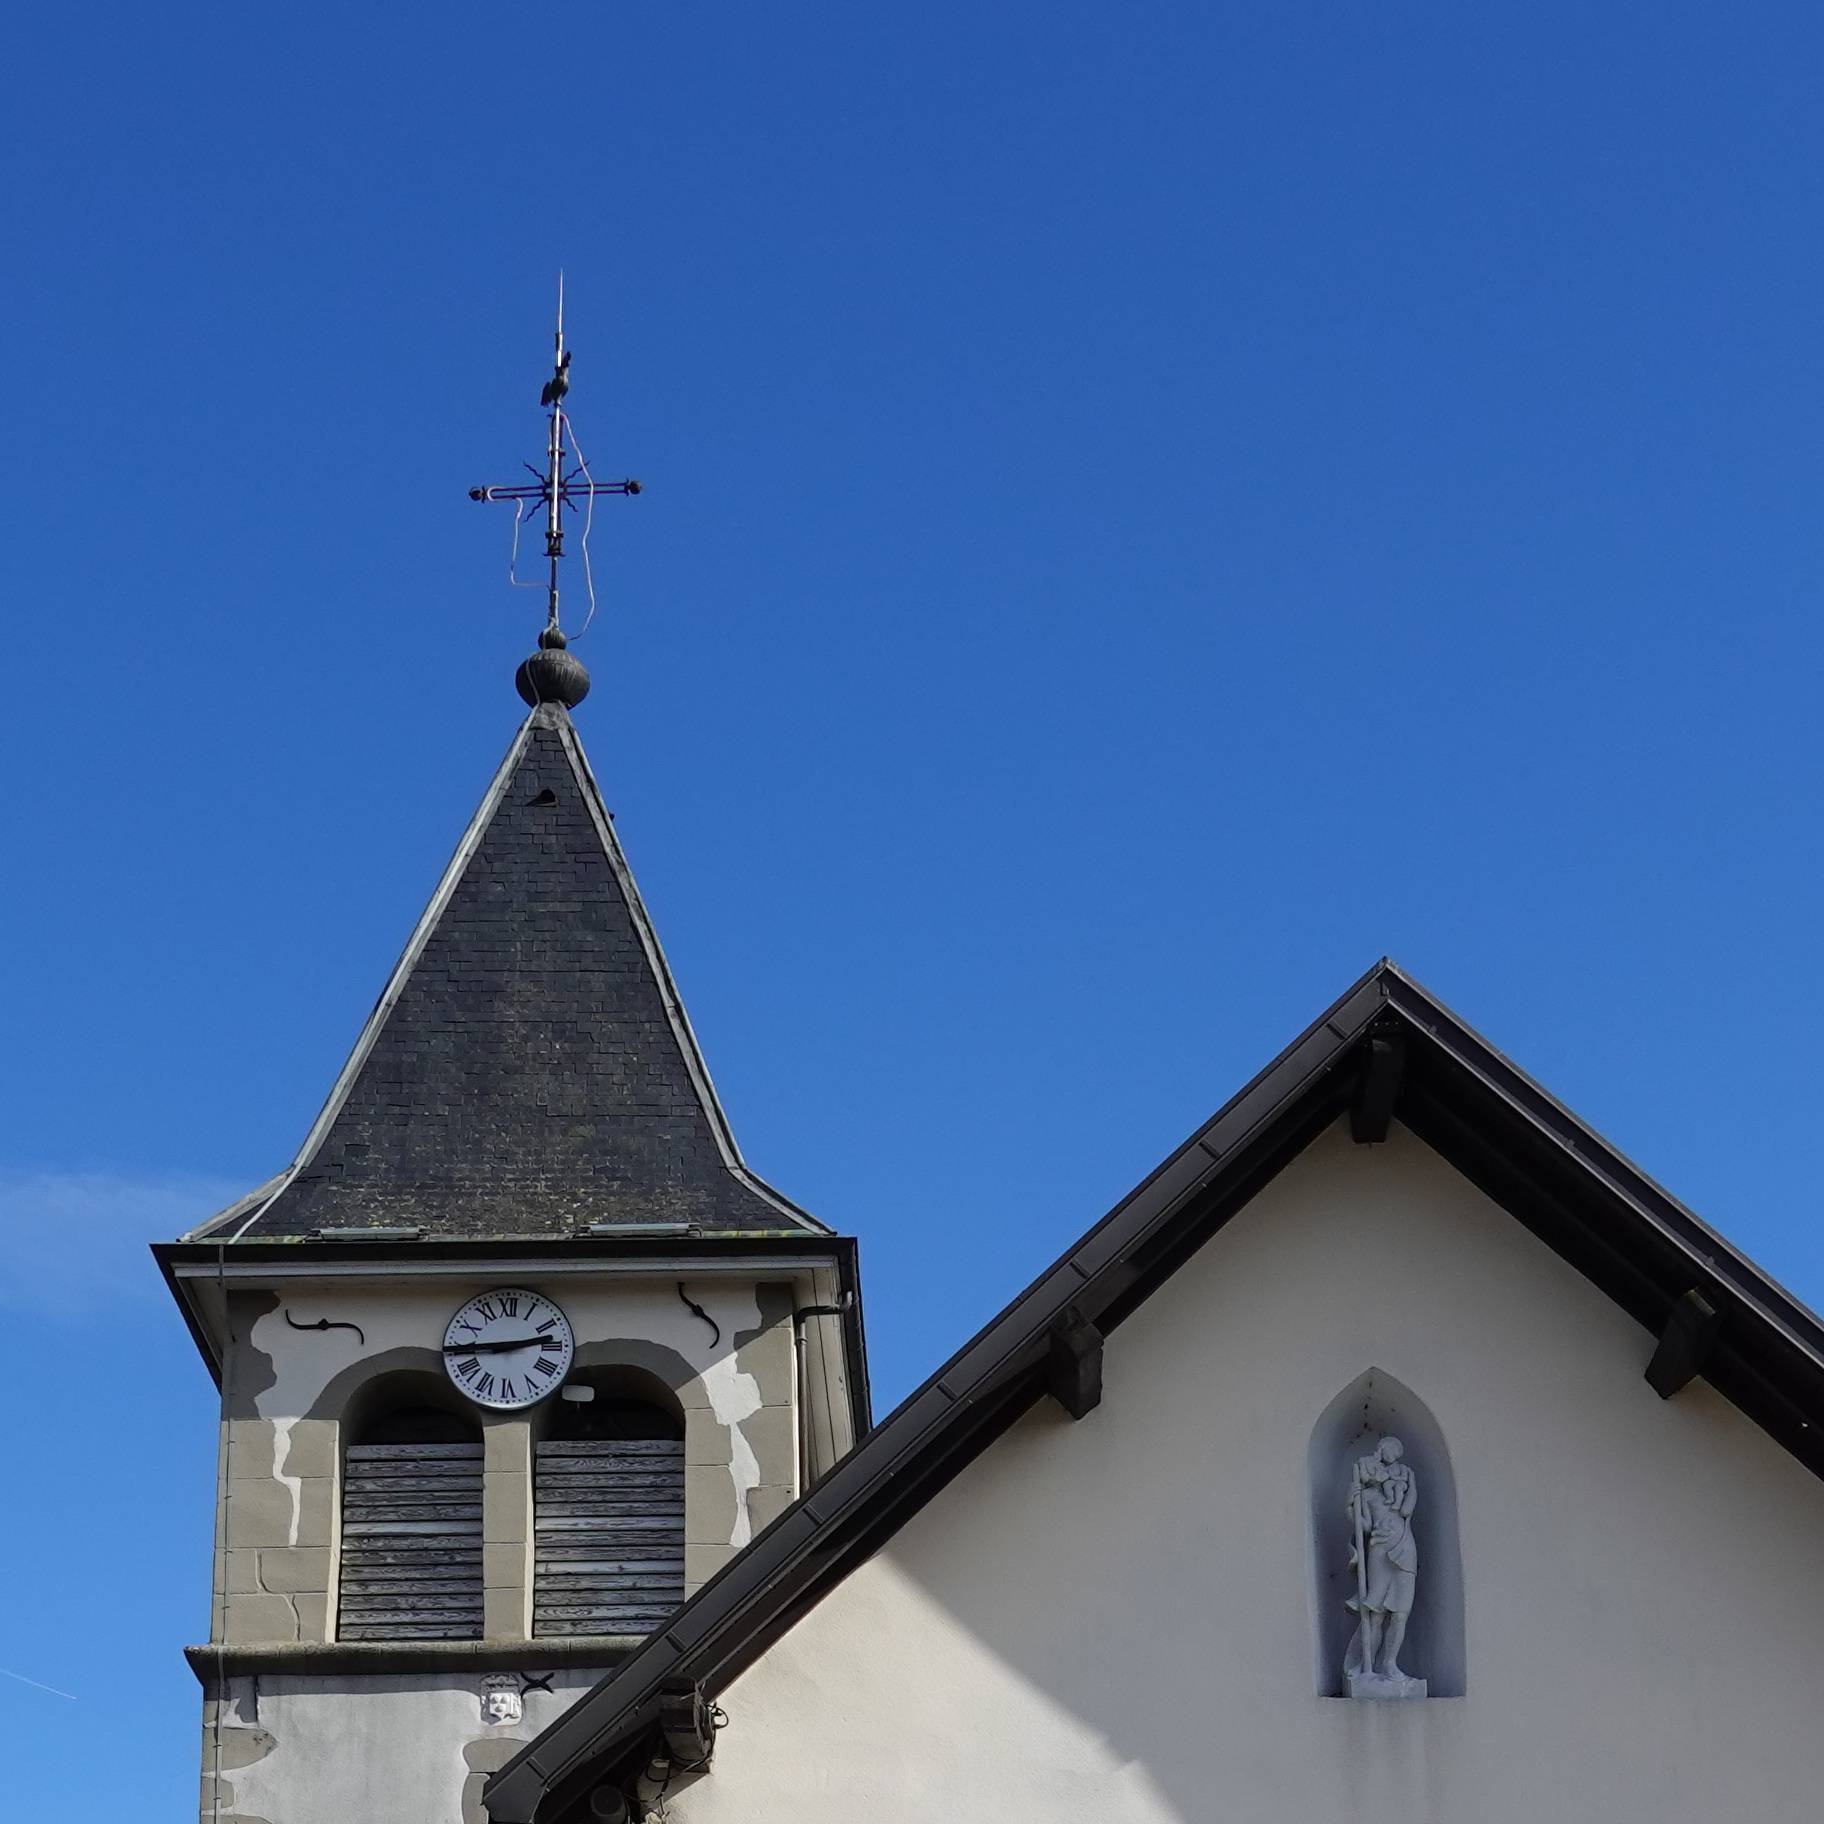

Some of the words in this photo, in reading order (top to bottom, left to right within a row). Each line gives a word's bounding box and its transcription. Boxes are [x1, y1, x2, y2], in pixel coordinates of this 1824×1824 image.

[475, 1302, 498, 1325] XI
[497, 1297, 518, 1318] XII
[523, 1302, 537, 1321] I
[459, 1319, 482, 1338] X
[535, 1318, 557, 1335] II
[541, 1340, 563, 1353] III
[457, 1357, 481, 1383] VIII
[532, 1356, 559, 1378] IIII
[475, 1371, 495, 1397] VII
[501, 1378, 517, 1399] VI
[523, 1373, 541, 1394] V
